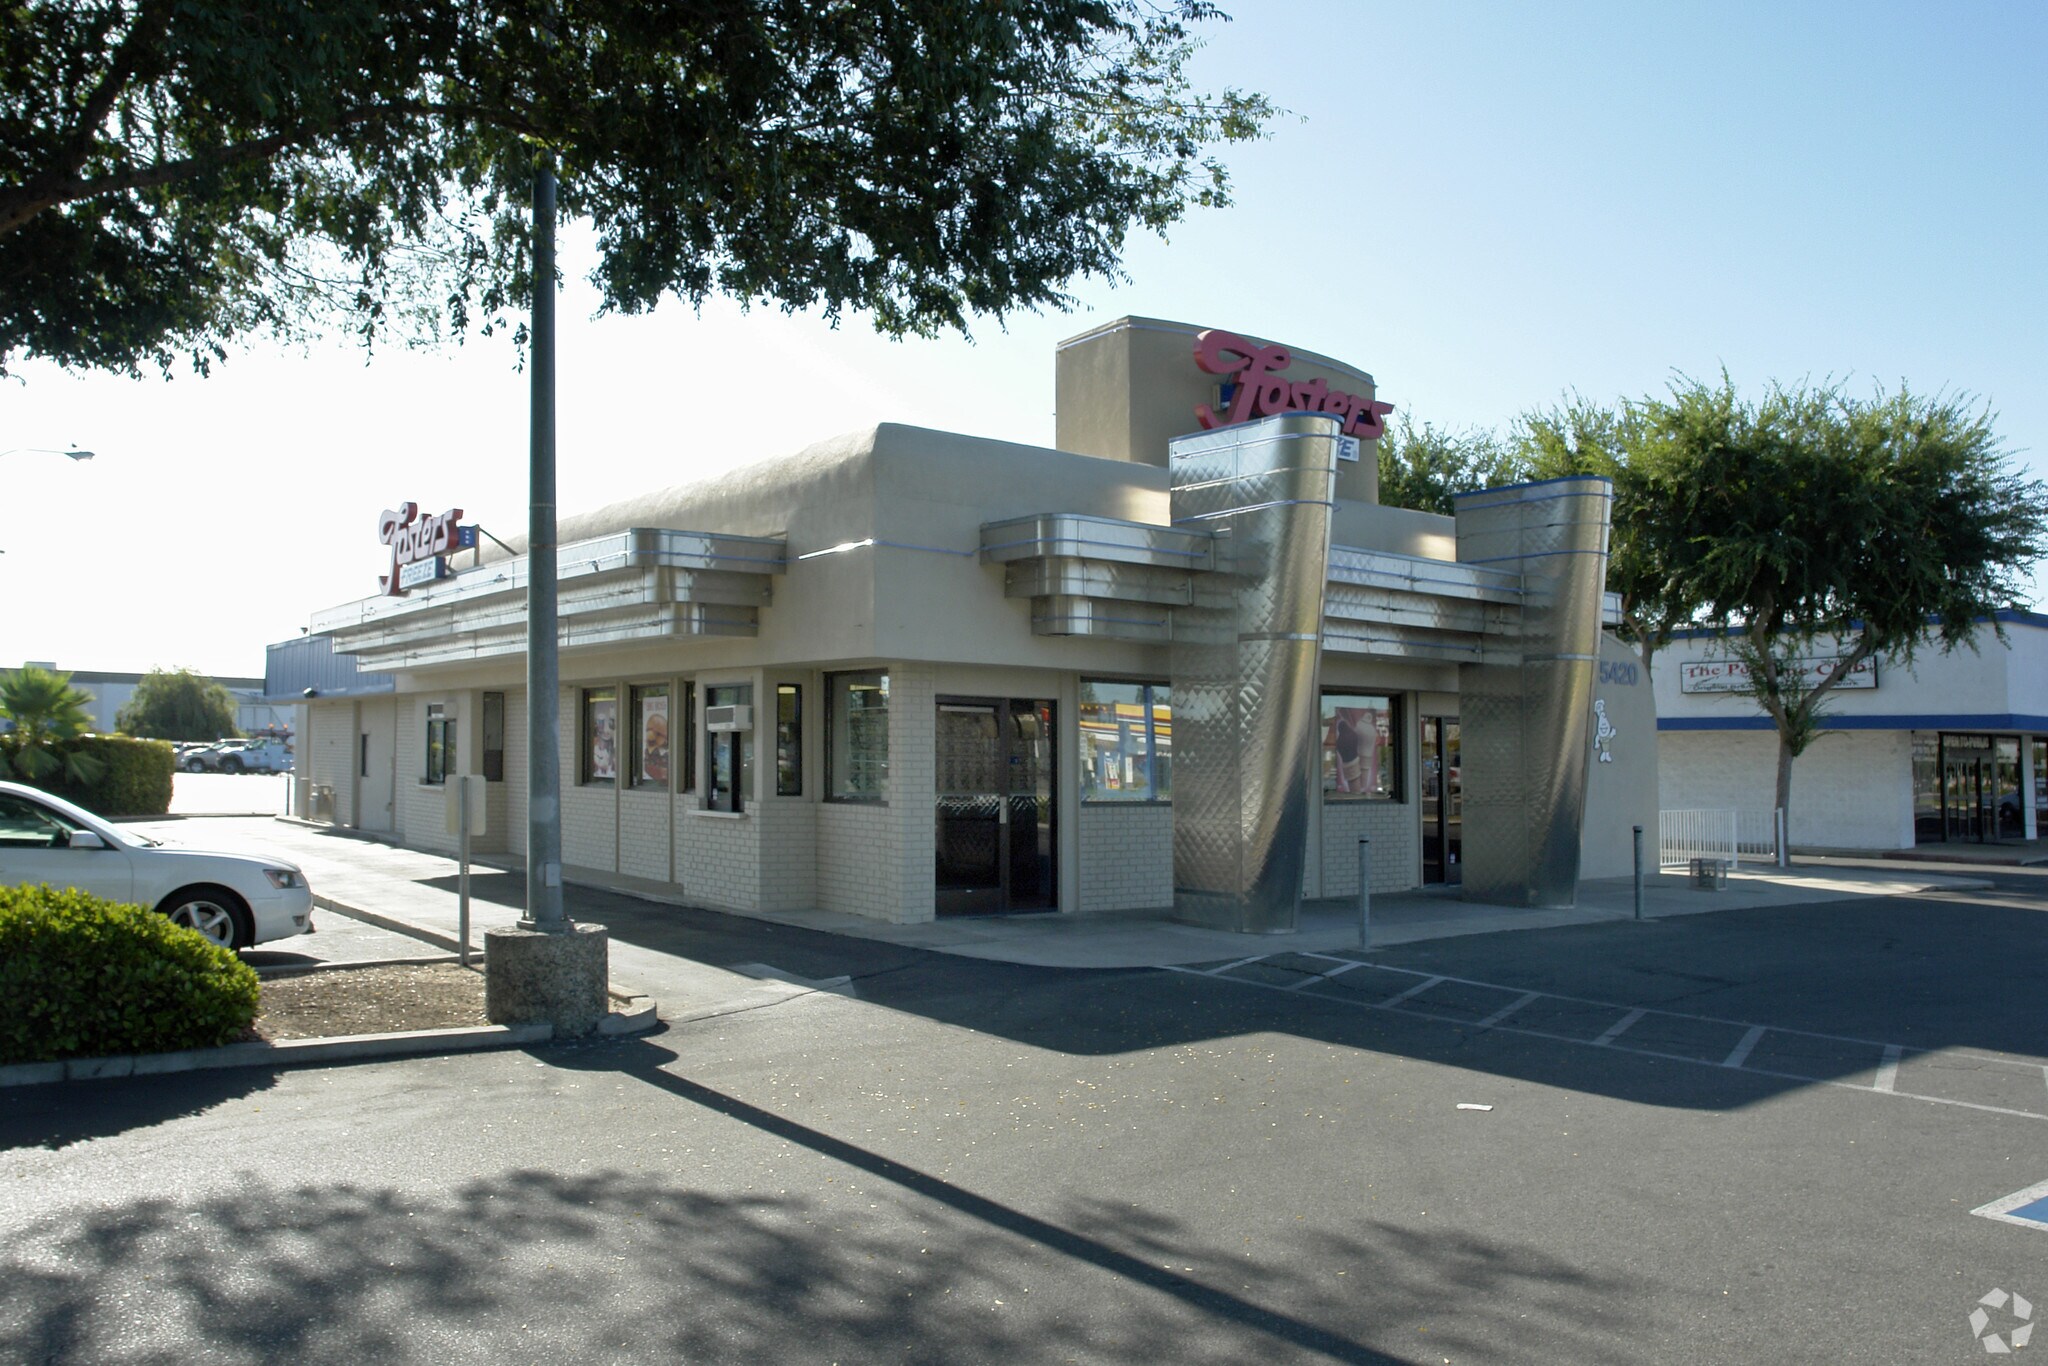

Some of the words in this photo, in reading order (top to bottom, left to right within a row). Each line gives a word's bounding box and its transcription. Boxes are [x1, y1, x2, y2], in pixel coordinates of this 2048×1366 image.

[1194, 330, 1394, 438] Fosters
[379, 502, 463, 596] Fosters
[401, 561, 435, 586] FREEZE
[1600, 660, 1639, 686] 5420
[1686, 664, 1721, 678] The
